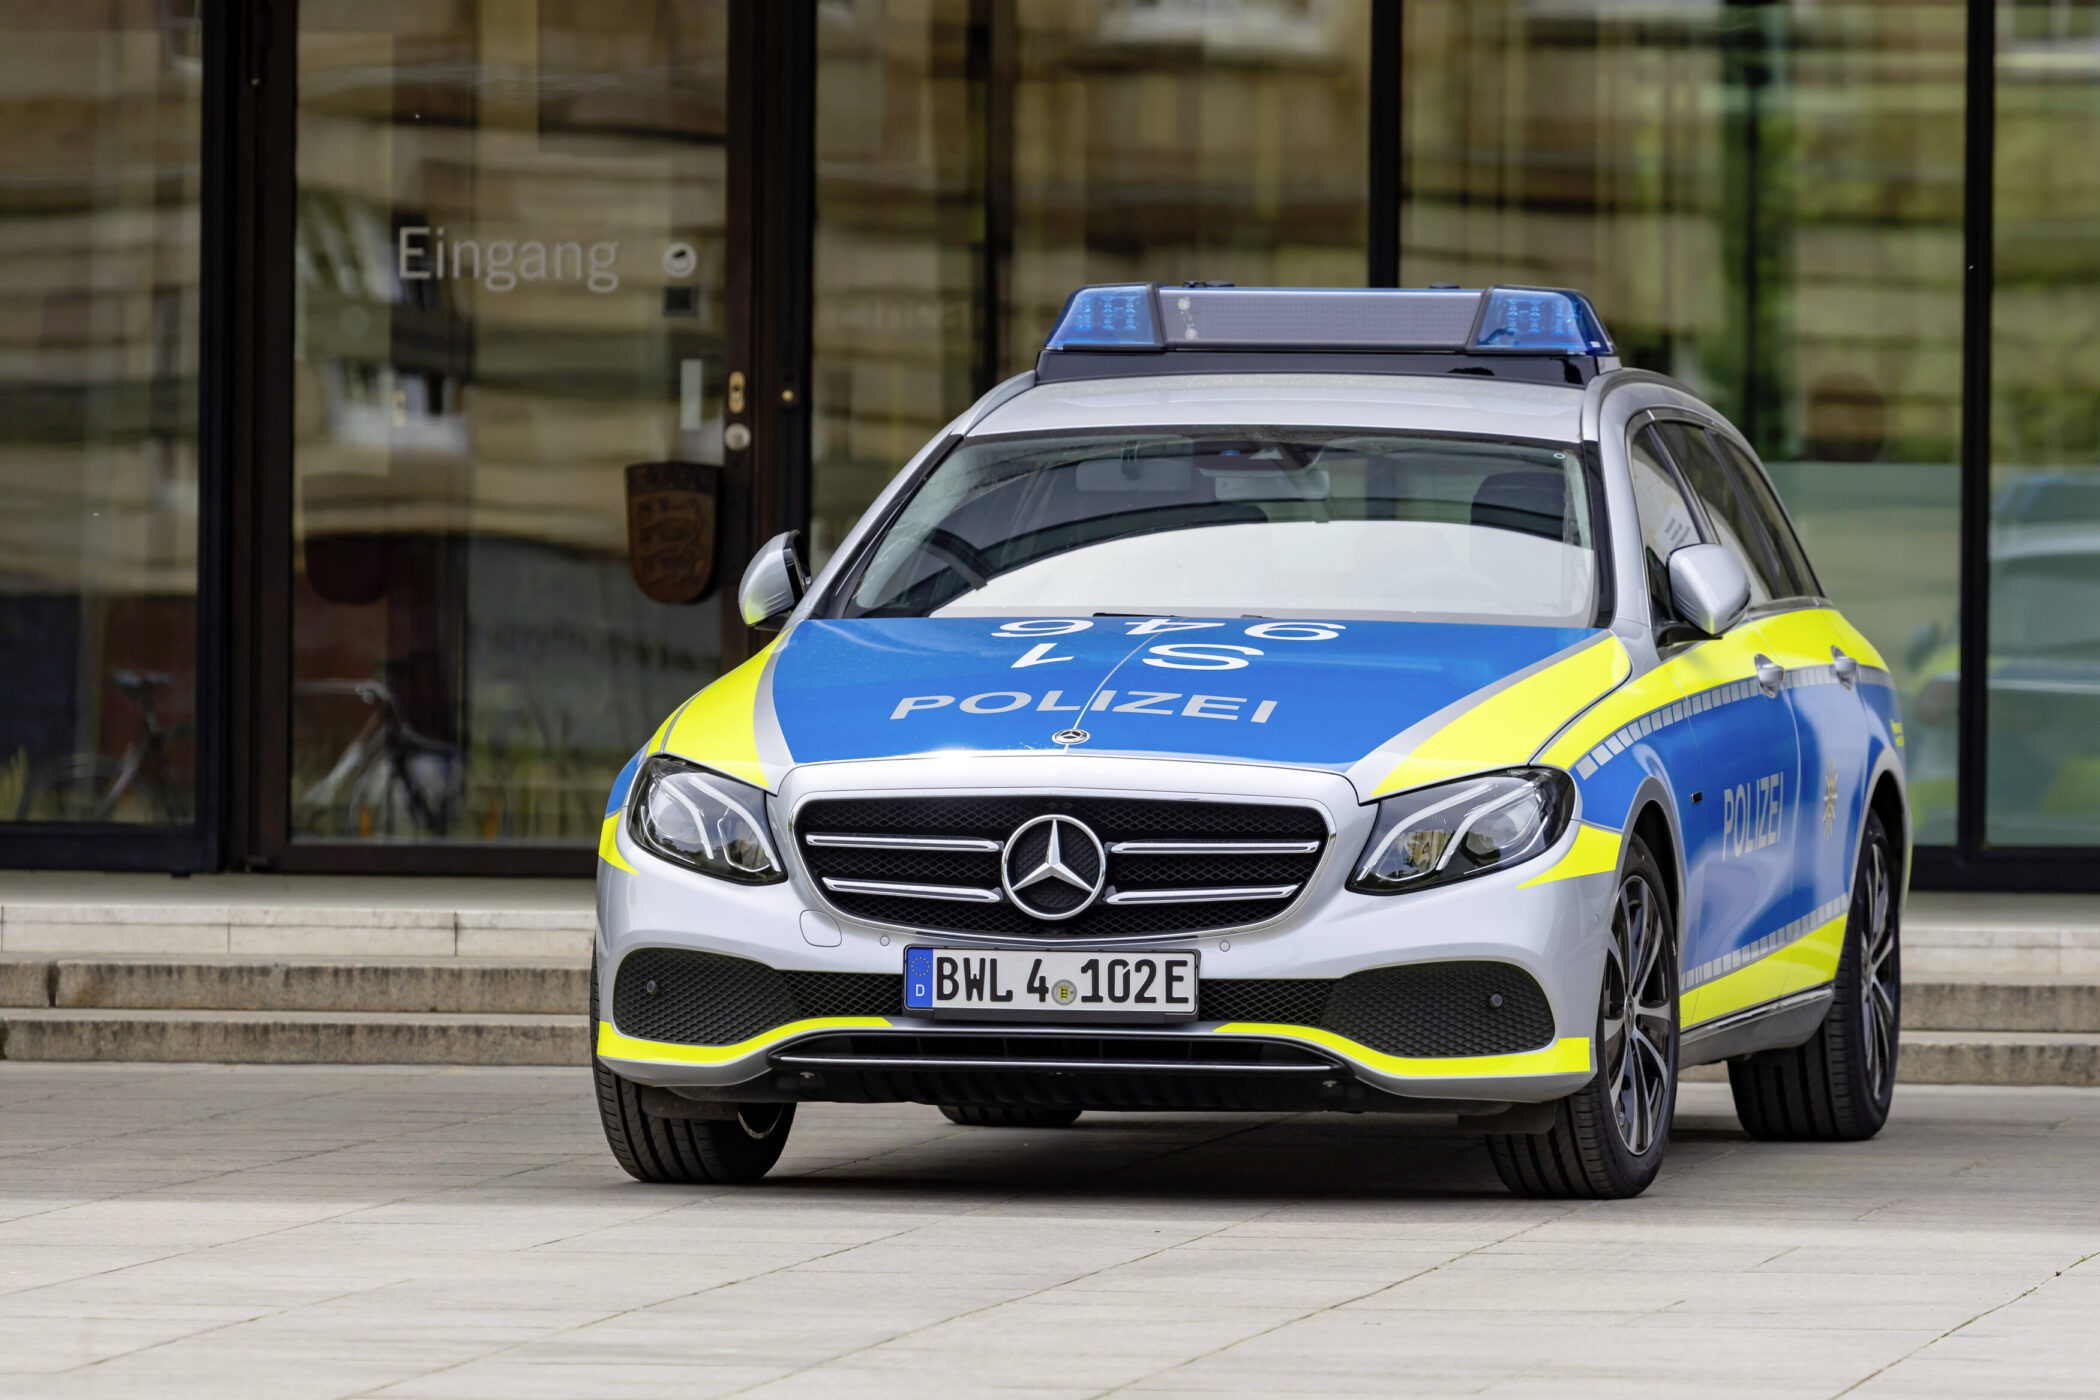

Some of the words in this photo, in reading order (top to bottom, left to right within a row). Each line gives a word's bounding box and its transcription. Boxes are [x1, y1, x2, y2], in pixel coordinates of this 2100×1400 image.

[399, 226, 619, 293] Eingang
[991, 618, 1347, 641] 946
[889, 690, 1278, 724] POLIZEI
[1722, 771, 1784, 862] POLIZEI
[915, 983, 925, 997] D
[936, 956, 1013, 1002] BWL
[1026, 957, 1049, 1003] 4
[1080, 958, 1190, 1004] 102E
